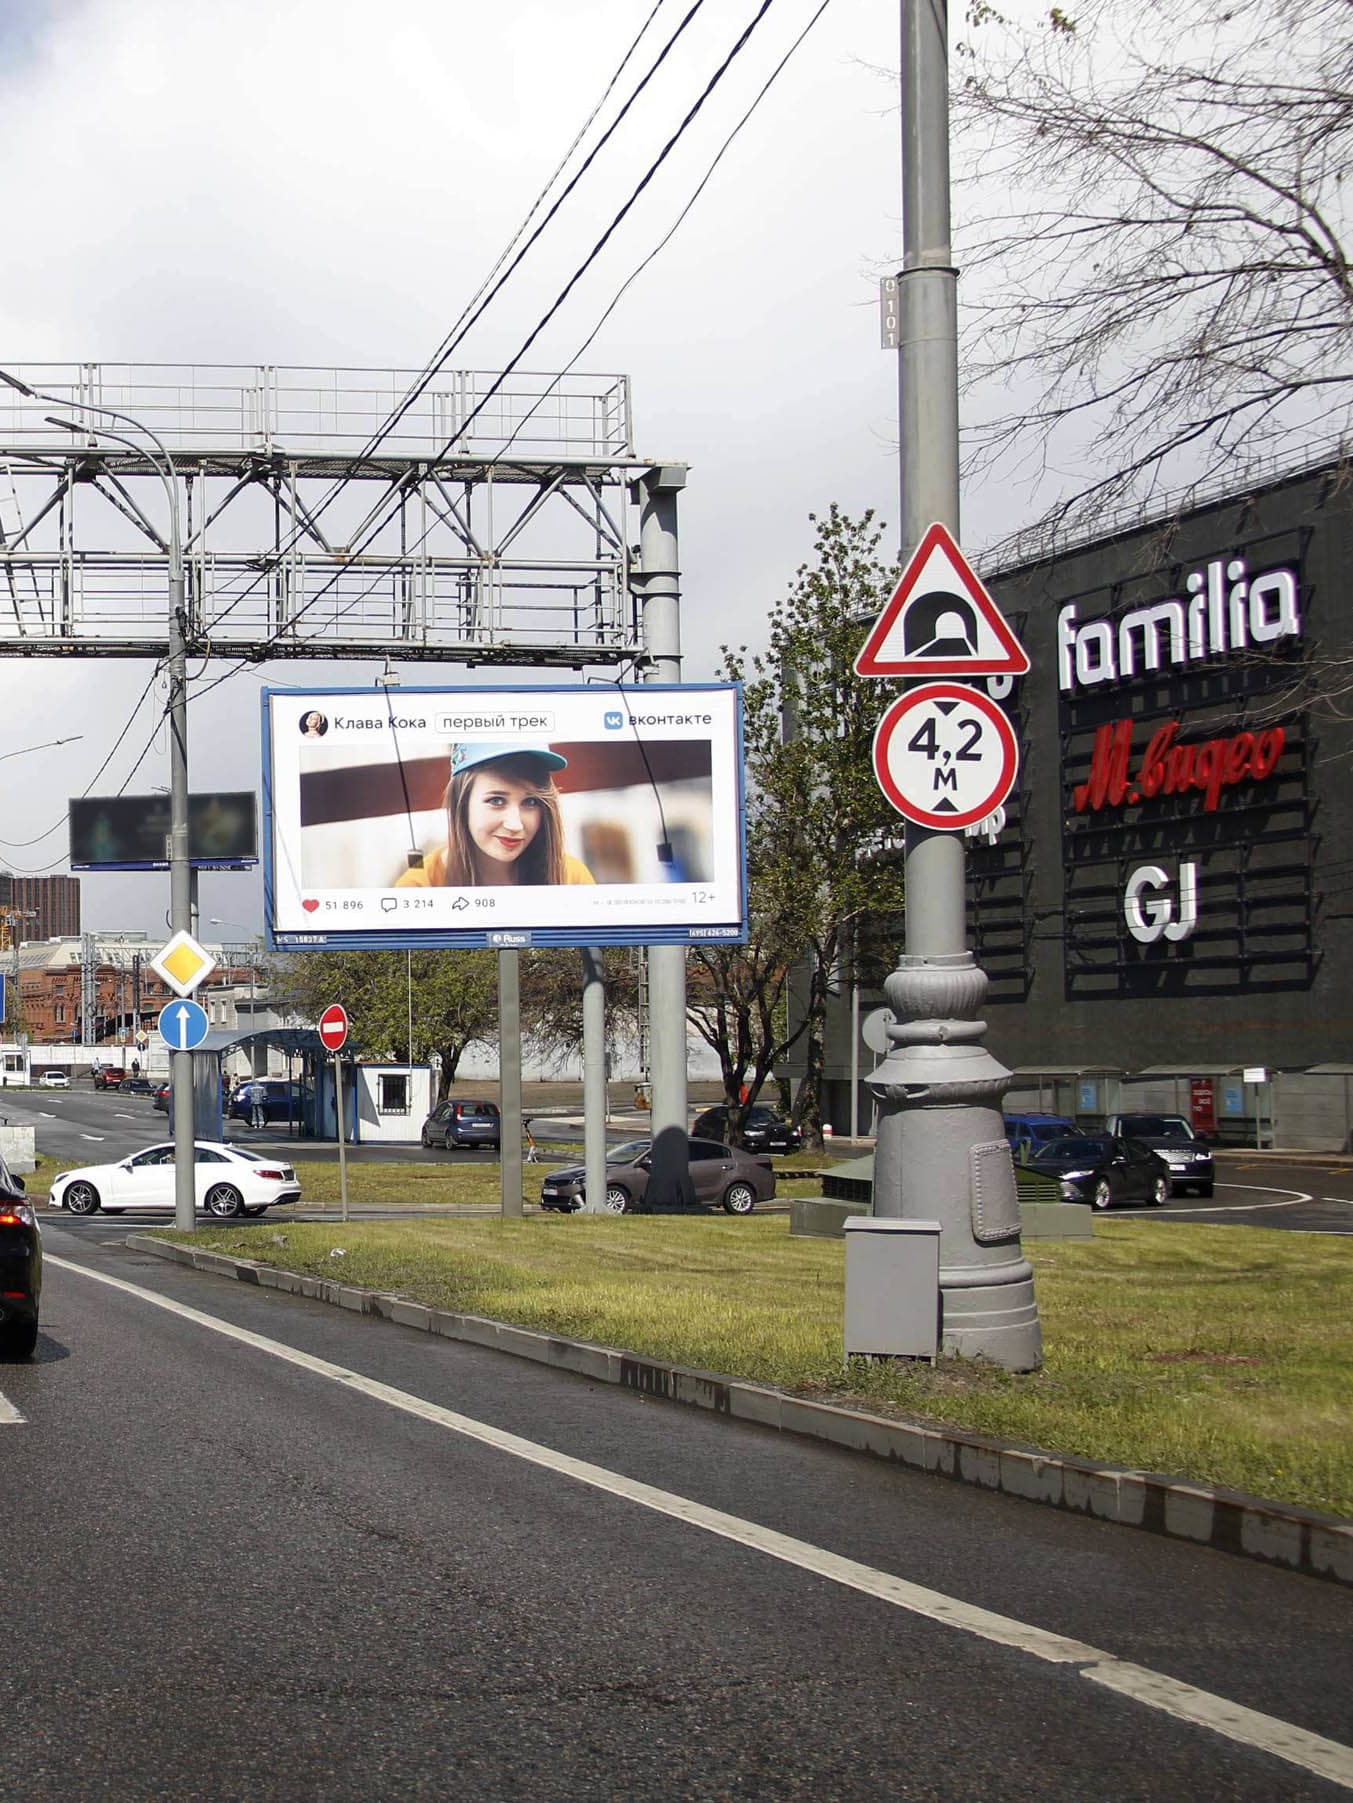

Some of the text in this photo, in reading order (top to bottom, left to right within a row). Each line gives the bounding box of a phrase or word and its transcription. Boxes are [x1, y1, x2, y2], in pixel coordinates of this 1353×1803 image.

[1057, 560, 1301, 691] familia
[334, 716, 427, 730] Клава Кока
[442, 714, 548, 732] первый трек
[629, 714, 712, 726] вконтакте
[908, 717, 983, 766] 4,2
[1072, 718, 1287, 813] М.видео
[403, 898, 434, 909] 3 214
[474, 898, 496, 908] 908
[692, 891, 716, 904] 12+
[1123, 861, 1198, 943] GJ
[325, 900, 364, 911] 51 896
